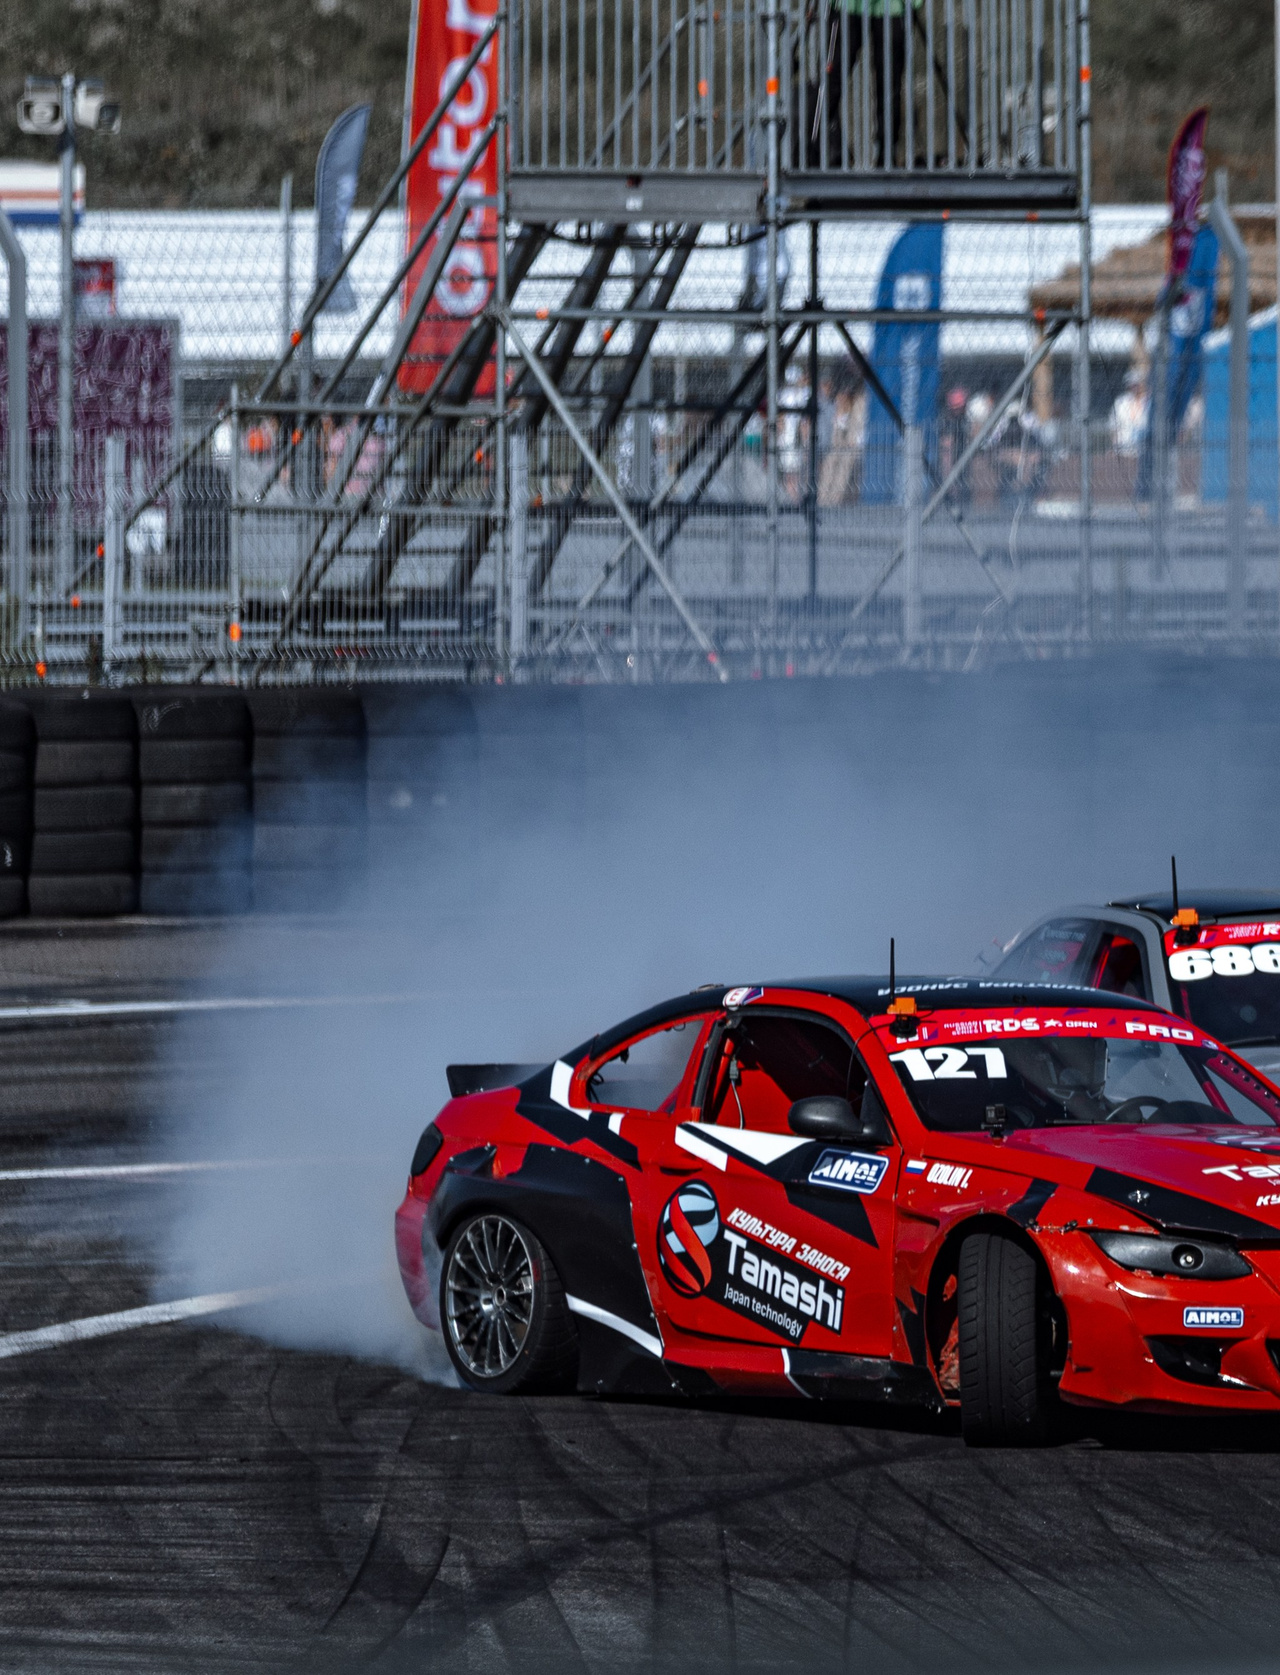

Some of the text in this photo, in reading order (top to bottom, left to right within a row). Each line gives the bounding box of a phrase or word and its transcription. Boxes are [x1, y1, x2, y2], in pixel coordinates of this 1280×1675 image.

[983, 1018, 1040, 1032] RDS
[1125, 1021, 1194, 1041] PRO
[889, 1047, 1007, 1081] 127
[814, 1156, 880, 1182] AIMOL
[926, 1163, 966, 1187] OZOLIN
[726, 1207, 851, 1282] КУЛЬТУРА ЗАНОСА
[723, 1229, 844, 1330] Tamashi
[724, 1283, 803, 1339] Japan technology
[1186, 1311, 1240, 1324] AIMOL
